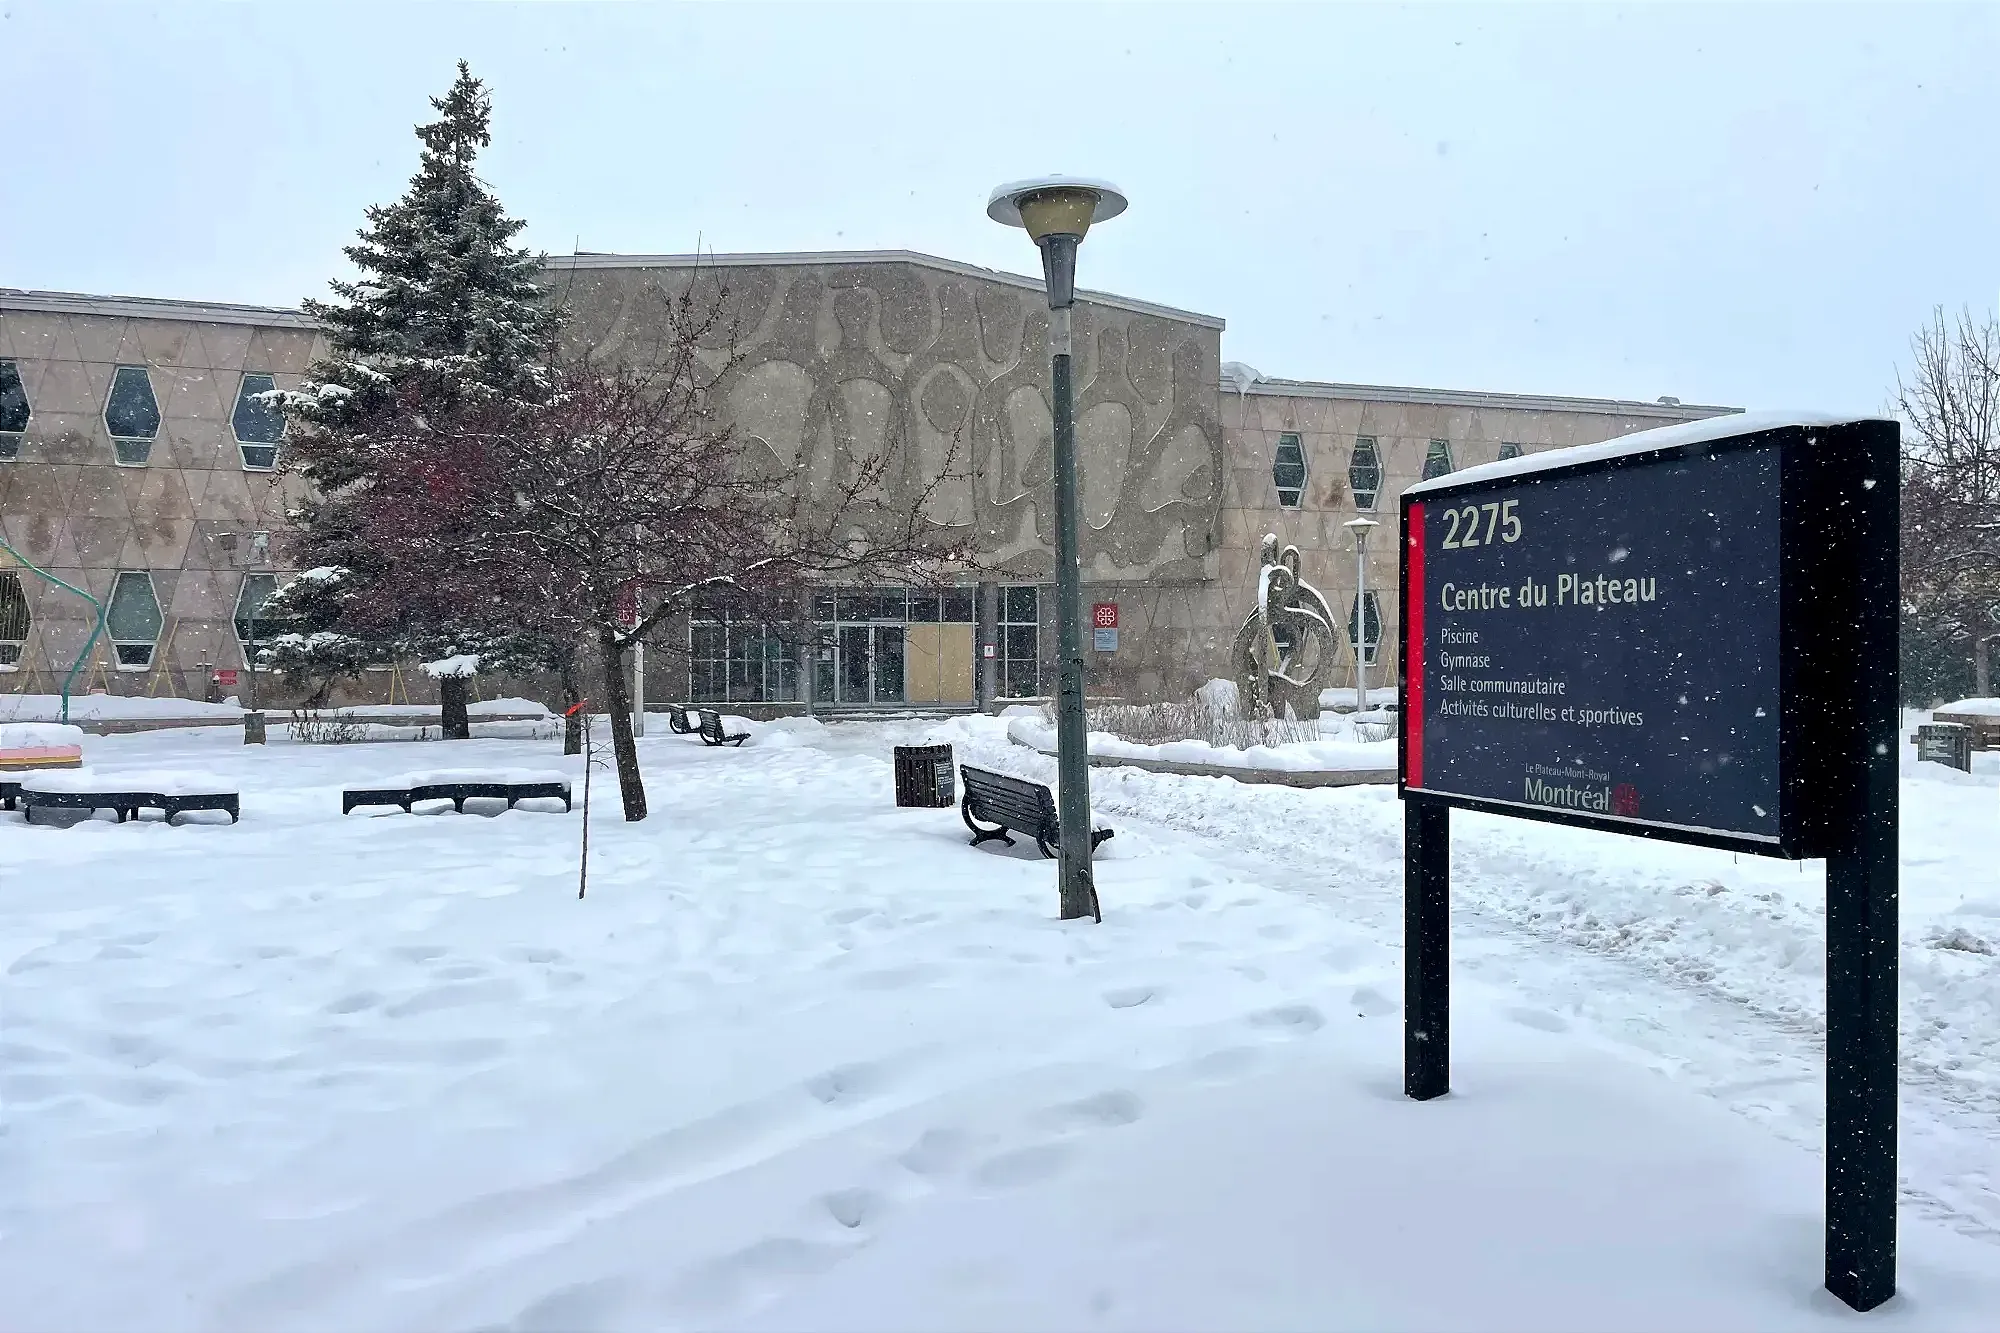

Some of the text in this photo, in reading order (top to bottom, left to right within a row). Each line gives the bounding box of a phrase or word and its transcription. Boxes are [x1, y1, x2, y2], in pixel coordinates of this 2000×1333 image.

[1442, 500, 1522, 549] 2275
[1441, 573, 1656, 611] Centre du Plateau
[1440, 628, 1479, 645] Piscine
[1440, 652, 1490, 670] Gymnase
[1440, 675, 1566, 696] Salle communautaire
[1440, 699, 1643, 727] Activités culturelles et sportives
[1525, 763, 1610, 782] Le Plateau-Mont-Royal
[1524, 777, 1611, 811] Montréal
